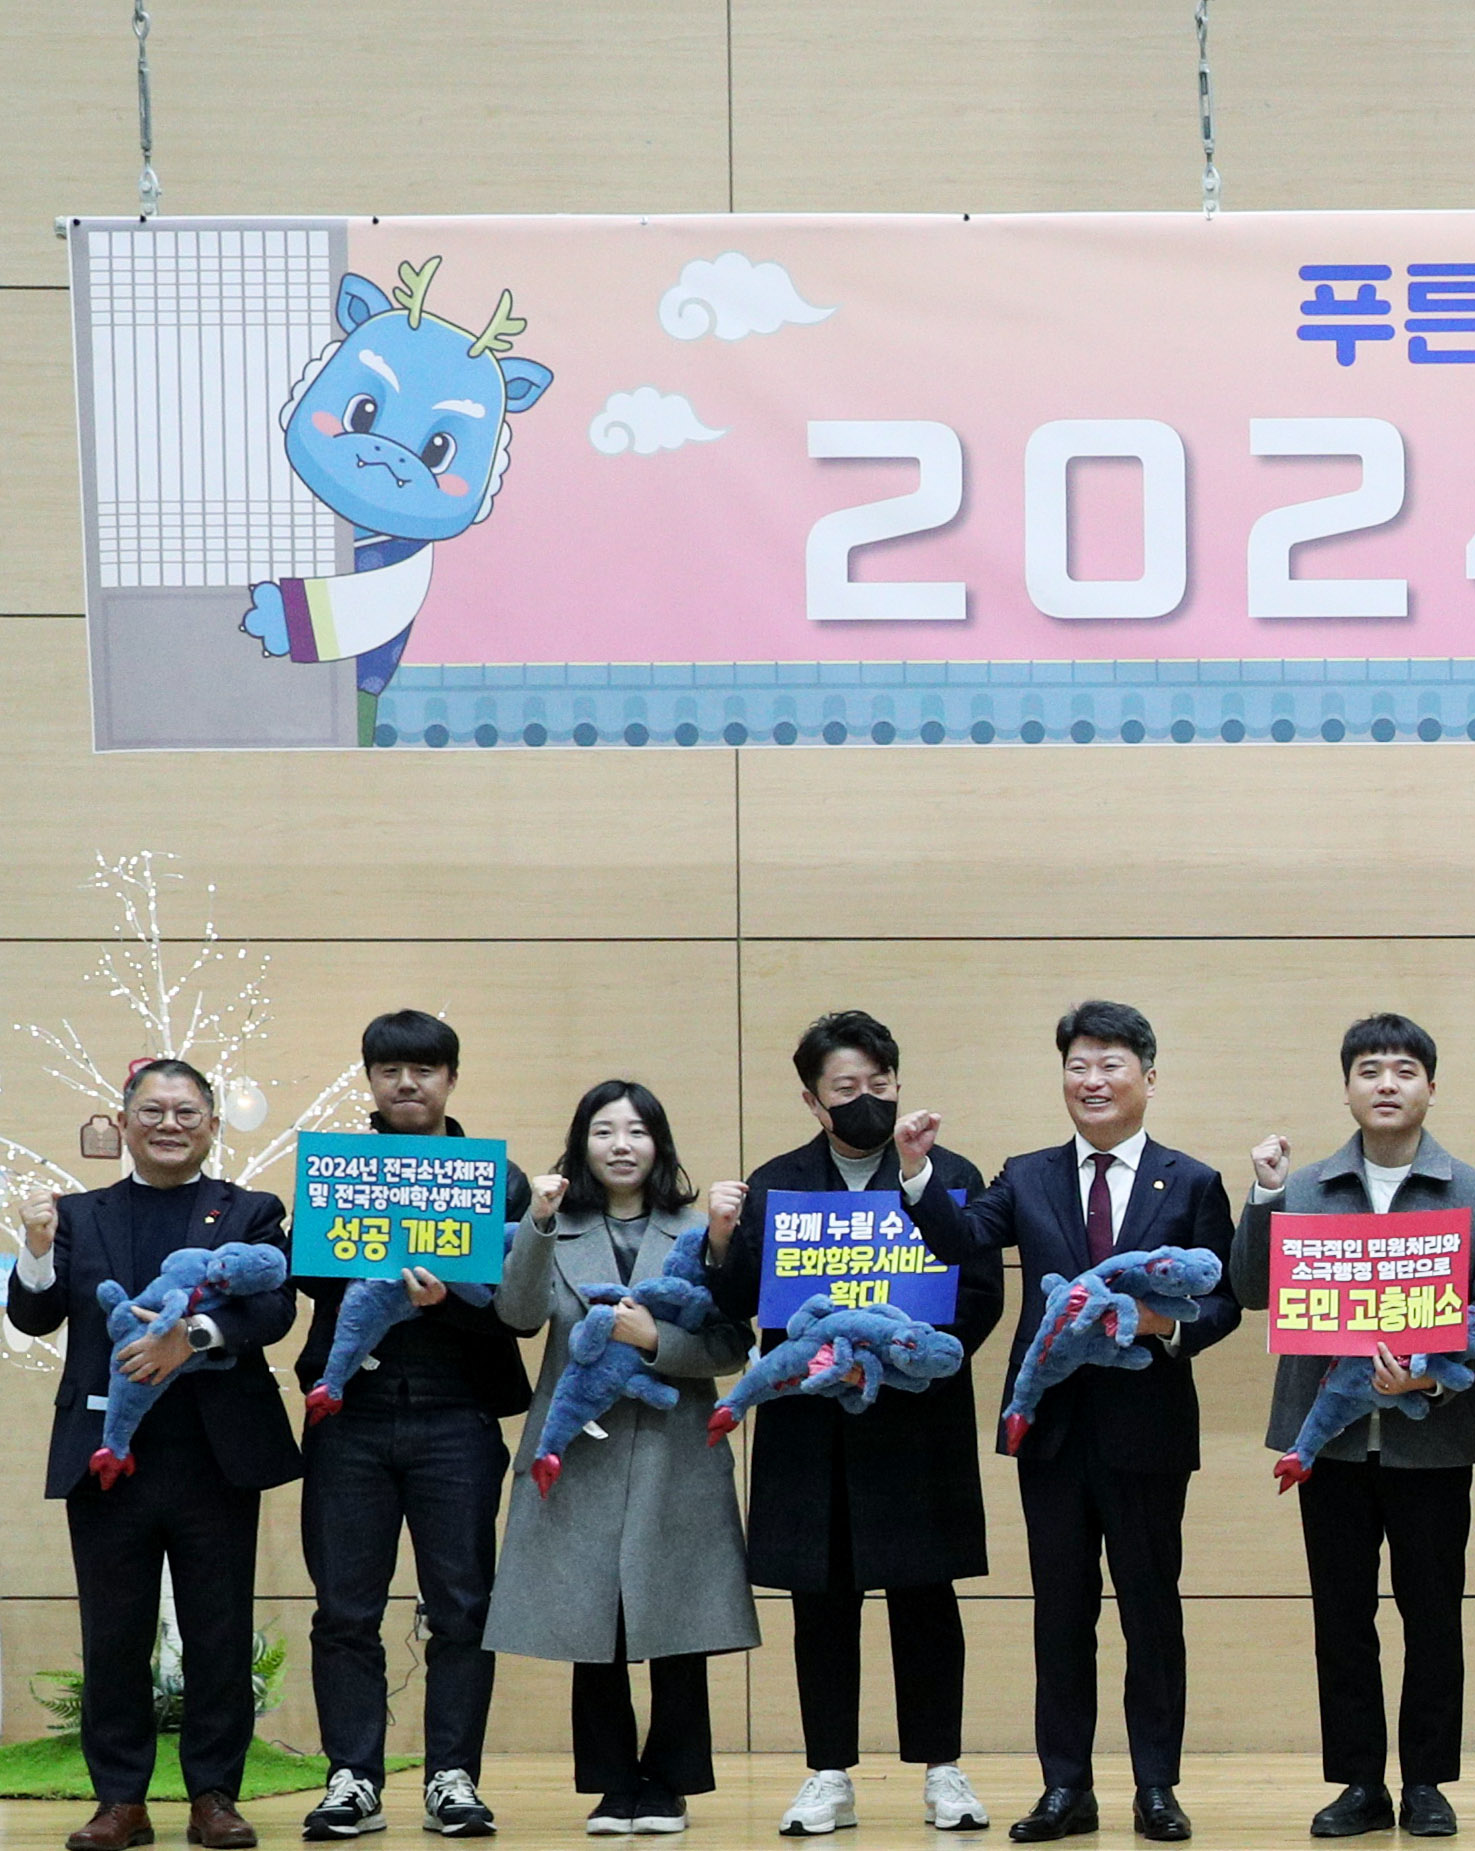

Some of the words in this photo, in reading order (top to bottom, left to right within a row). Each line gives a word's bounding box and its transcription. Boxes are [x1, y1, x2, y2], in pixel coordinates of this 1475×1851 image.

[306, 1155, 378, 1182] 2024년
[383, 1157, 496, 1187] 전국소년체전
[308, 1183, 329, 1208] 및
[334, 1183, 492, 1214] 전국장애학생체전
[326, 1216, 391, 1262] 성공
[401, 1218, 472, 1257] 개최
[774, 1212, 823, 1242] 함께
[827, 1210, 875, 1241] 누릴
[879, 1210, 904, 1241] 수
[775, 1245, 949, 1277] 문화향유서비스
[1282, 1239, 1363, 1259] 적극적인
[1367, 1233, 1461, 1258] 민원처리와
[1291, 1261, 1372, 1282] 소극행정
[1377, 1257, 1452, 1281] 엄단으로
[829, 1279, 890, 1309] 확대
[1276, 1287, 1340, 1332] 도민
[1346, 1283, 1463, 1333] 고충해소
